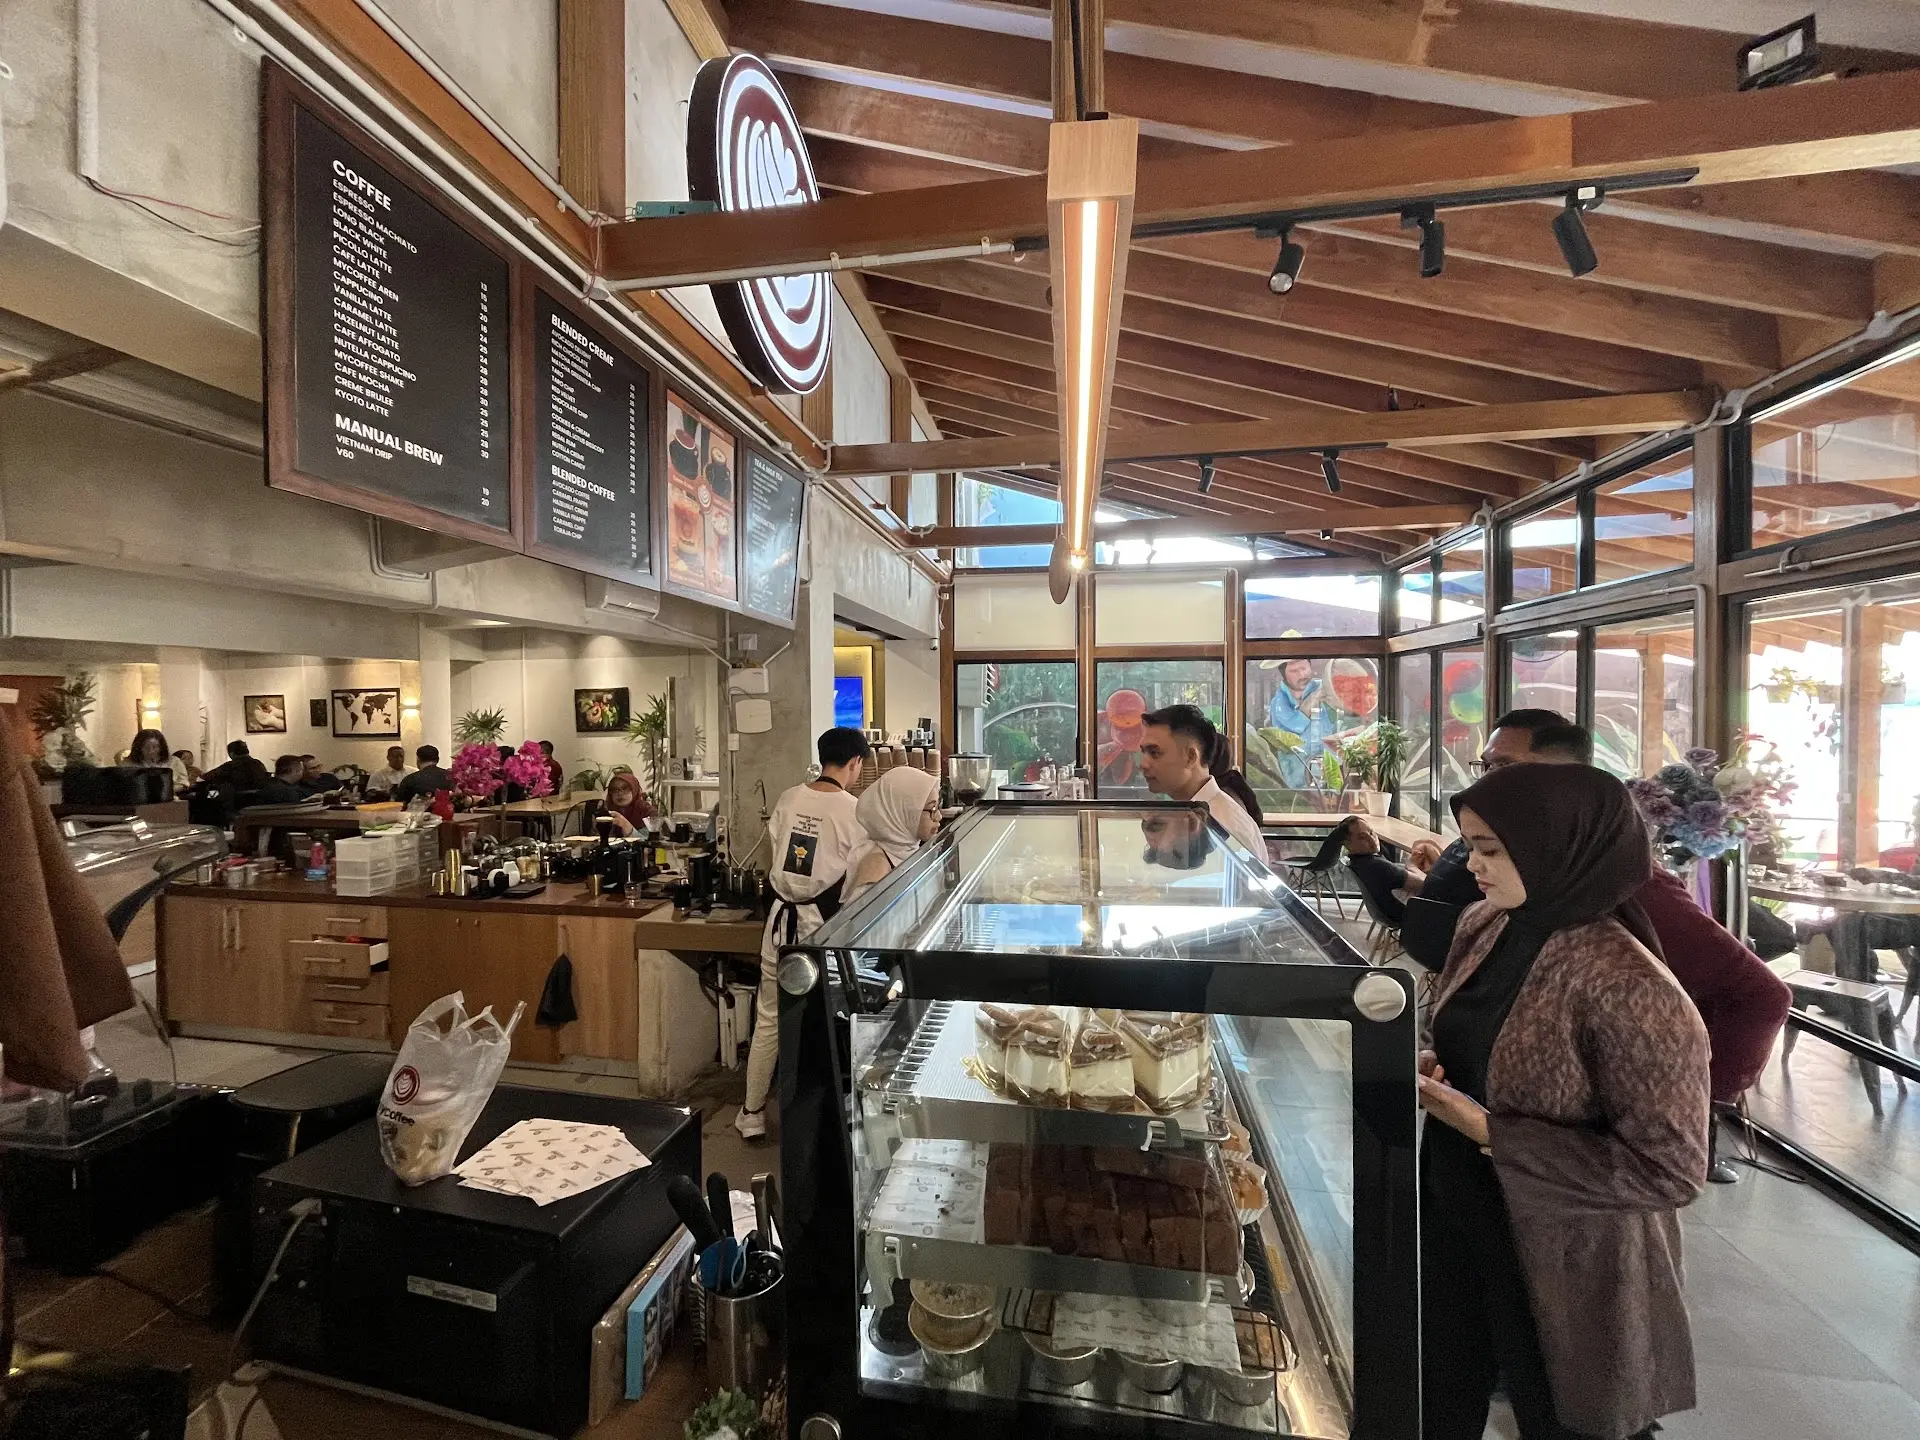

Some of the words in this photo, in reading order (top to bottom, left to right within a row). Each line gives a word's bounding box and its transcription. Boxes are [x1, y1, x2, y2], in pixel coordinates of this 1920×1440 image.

[333, 160, 391, 211] COFFEE
[333, 179, 374, 212] ESPRESSO
[333, 192, 374, 225] ESPRESSO
[376, 221, 417, 253] MACHIATO
[333, 205, 357, 226] LONG
[359, 222, 384, 245] BLACK
[333, 218, 360, 241] BLACK
[362, 237, 387, 259] WHITE
[333, 231, 368, 258] PICOLLO
[370, 254, 392, 274] LATTE
[333, 245, 355, 264] CAFE
[357, 259, 380, 279] LATTE
[333, 257, 377, 289] MYCOFFEE
[378, 285, 399, 302] AREN
[333, 271, 383, 304] CAPPUCINO
[334, 283, 368, 308] VANILLA
[370, 303, 392, 322] LATTE
[334, 297, 373, 324] CARAMEL
[375, 319, 398, 337] LATTE
[334, 309, 375, 337] HAZELNUT
[377, 332, 399, 350] LATTE
[334, 323, 357, 340] CAFE
[358, 336, 400, 362] AFFOGATO
[551, 314, 588, 347] BLENDED
[588, 342, 614, 367] CREME
[334, 336, 369, 359] NUTELLA
[371, 355, 416, 381] CAPPUCINO
[335, 349, 378, 375] MYCOFFEE
[380, 370, 404, 388] SHAKE
[335, 362, 357, 378] CAFE
[359, 372, 390, 393] MOCHA
[335, 375, 364, 394] CREME
[365, 389, 393, 407] BRULEE
[335, 388, 364, 406] KYOTO
[366, 401, 389, 417] LATTE
[335, 414, 402, 451] MANUAL
[404, 441, 443, 465] BREW
[336, 433, 373, 454] VIETNAM
[375, 447, 393, 460] DRIP
[336, 447, 354, 460] V60
[551, 464, 587, 488] BLENDED
[587, 482, 615, 501] COFFEE
[380, 1106, 415, 1126] ycoffee
